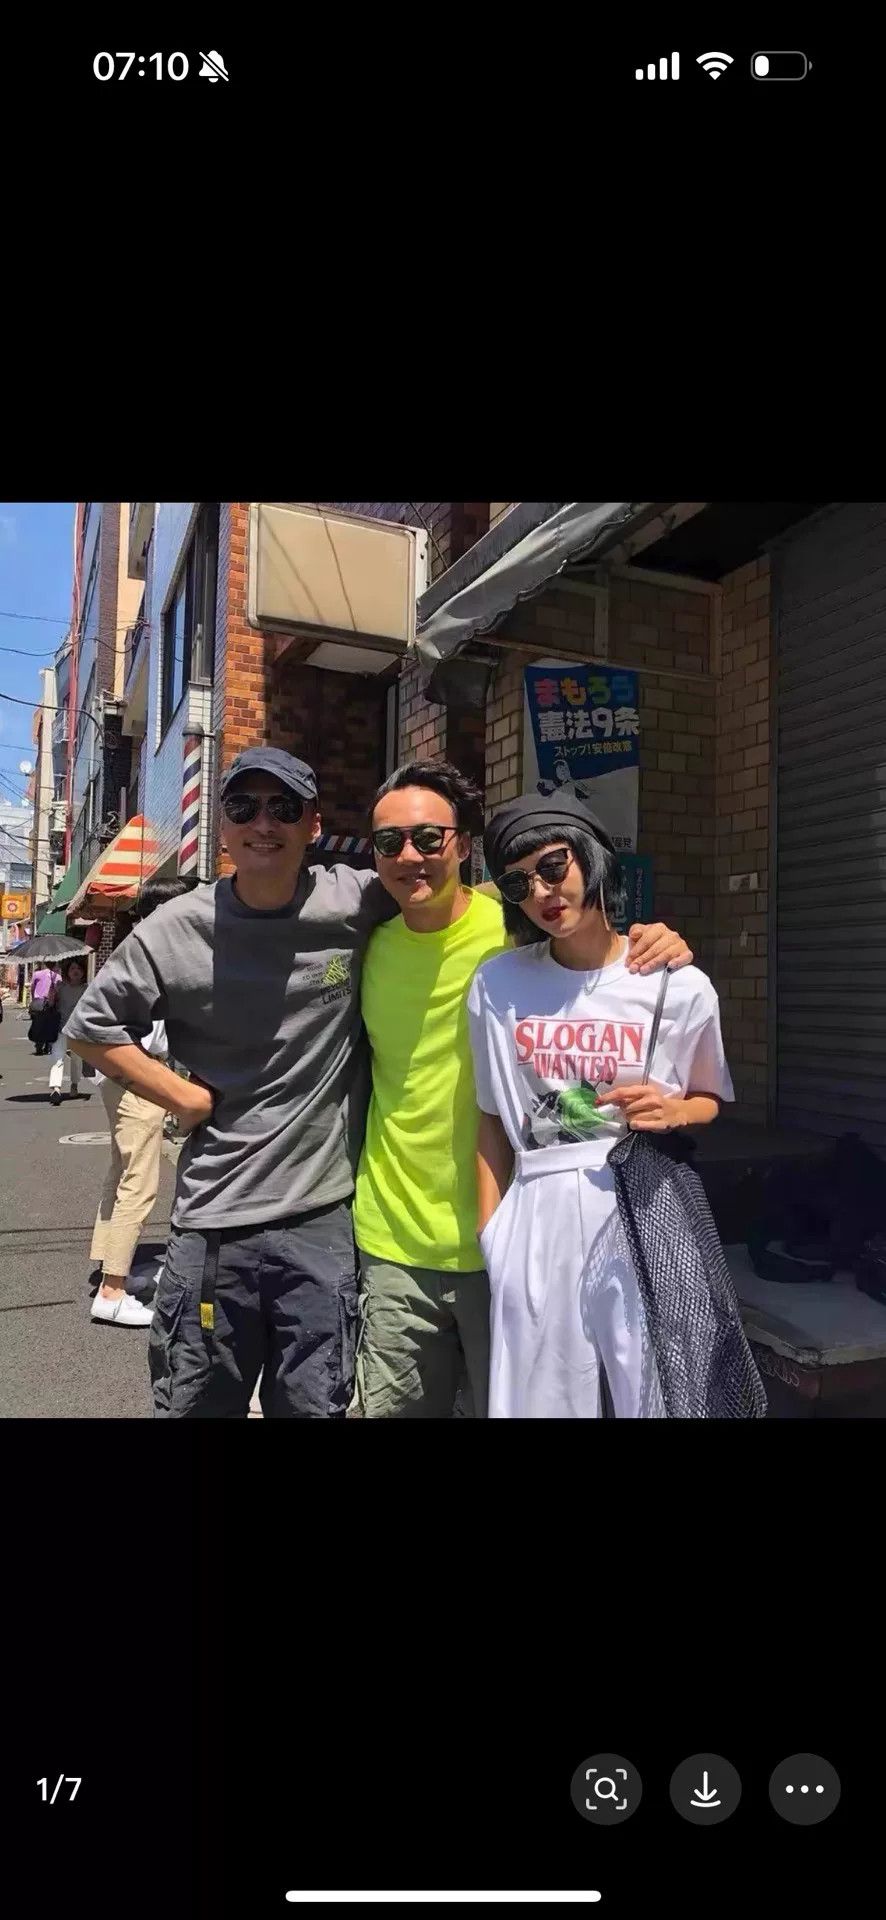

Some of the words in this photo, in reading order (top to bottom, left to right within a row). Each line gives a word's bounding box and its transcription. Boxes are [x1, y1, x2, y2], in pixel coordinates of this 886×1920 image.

[534, 676, 635, 705] まもろう
[538, 706, 640, 742] 憲法9条
[515, 1021, 645, 1063] SLOGAN
[533, 1052, 619, 1083] WANTED
